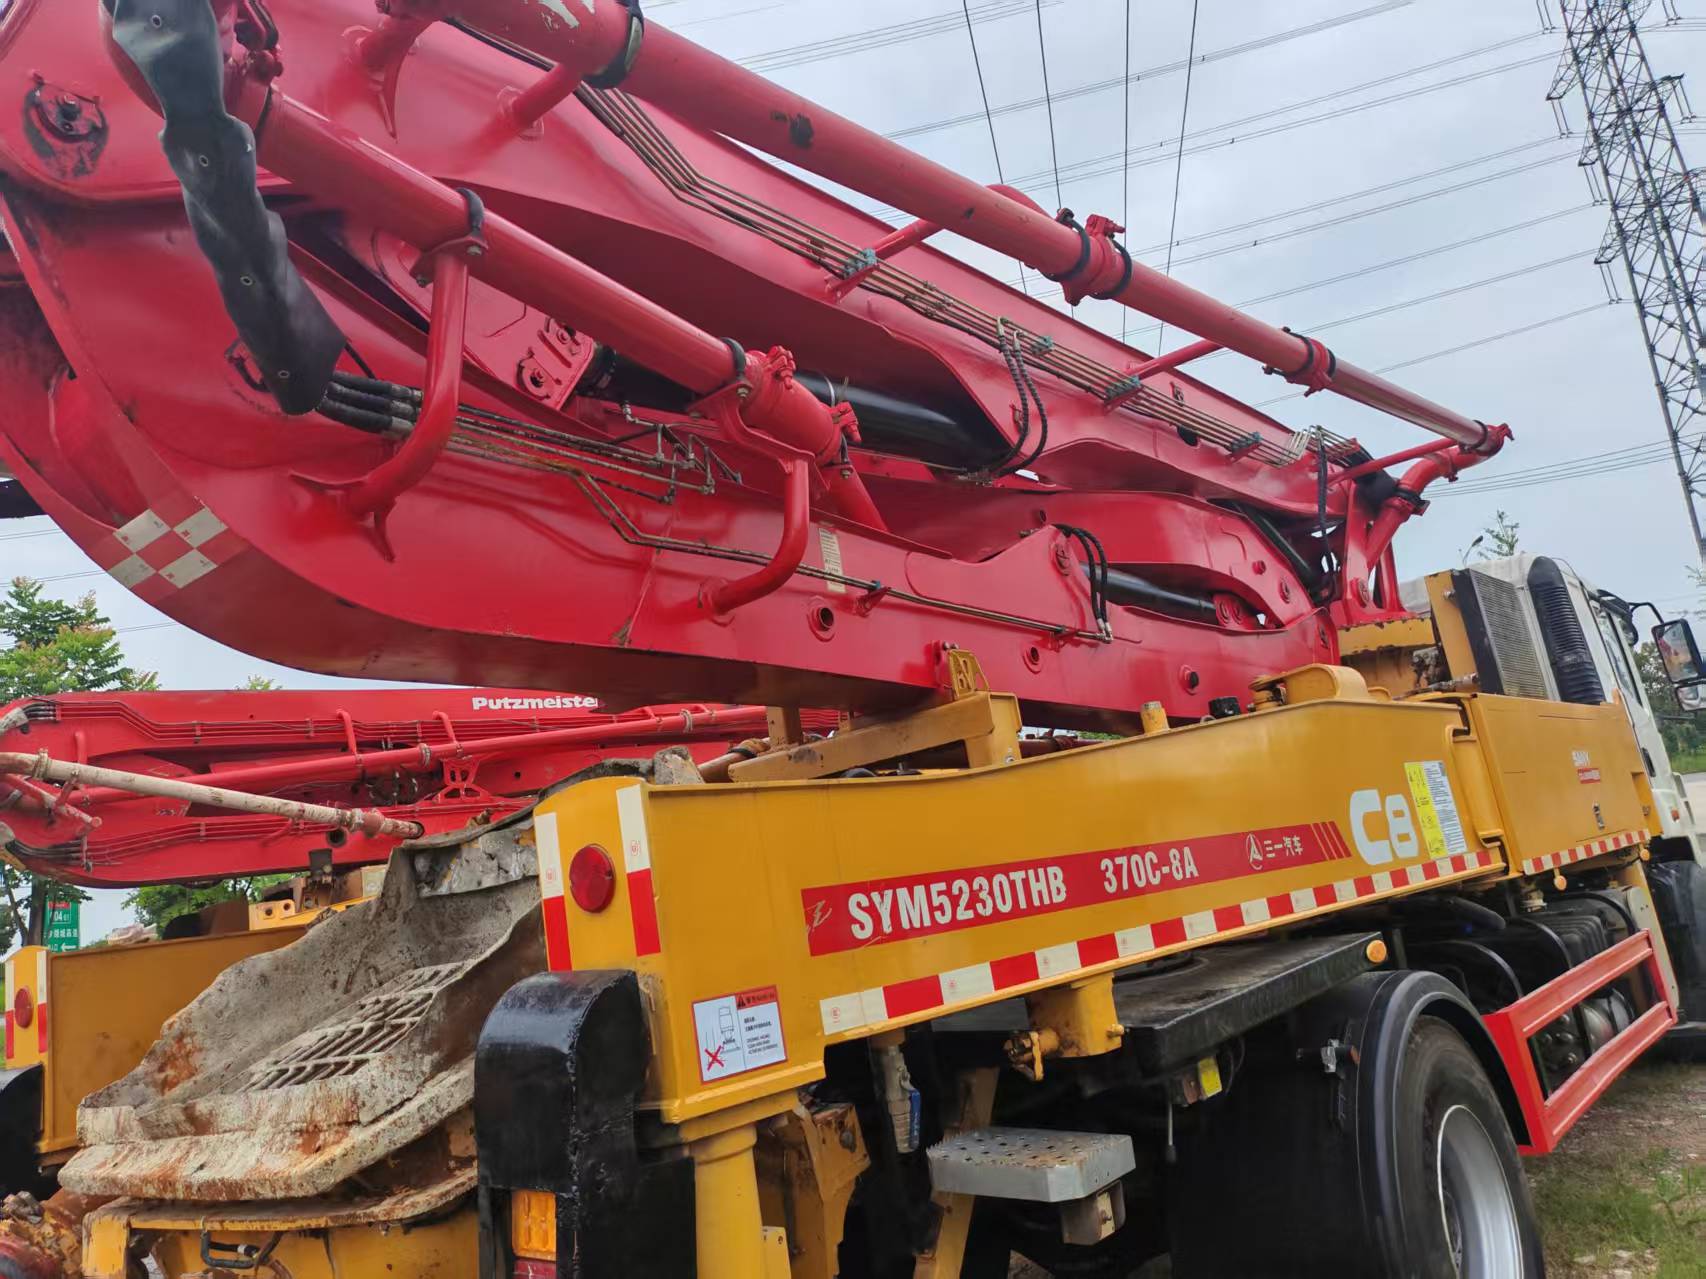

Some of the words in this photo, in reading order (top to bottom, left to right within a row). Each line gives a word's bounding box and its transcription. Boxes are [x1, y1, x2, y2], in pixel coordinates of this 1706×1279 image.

[1264, 835, 1303, 859] 三一汽车
[1350, 789, 1419, 865] C8
[1100, 846, 1199, 894] 370C-8A
[848, 866, 1067, 940] SYM5230THB
